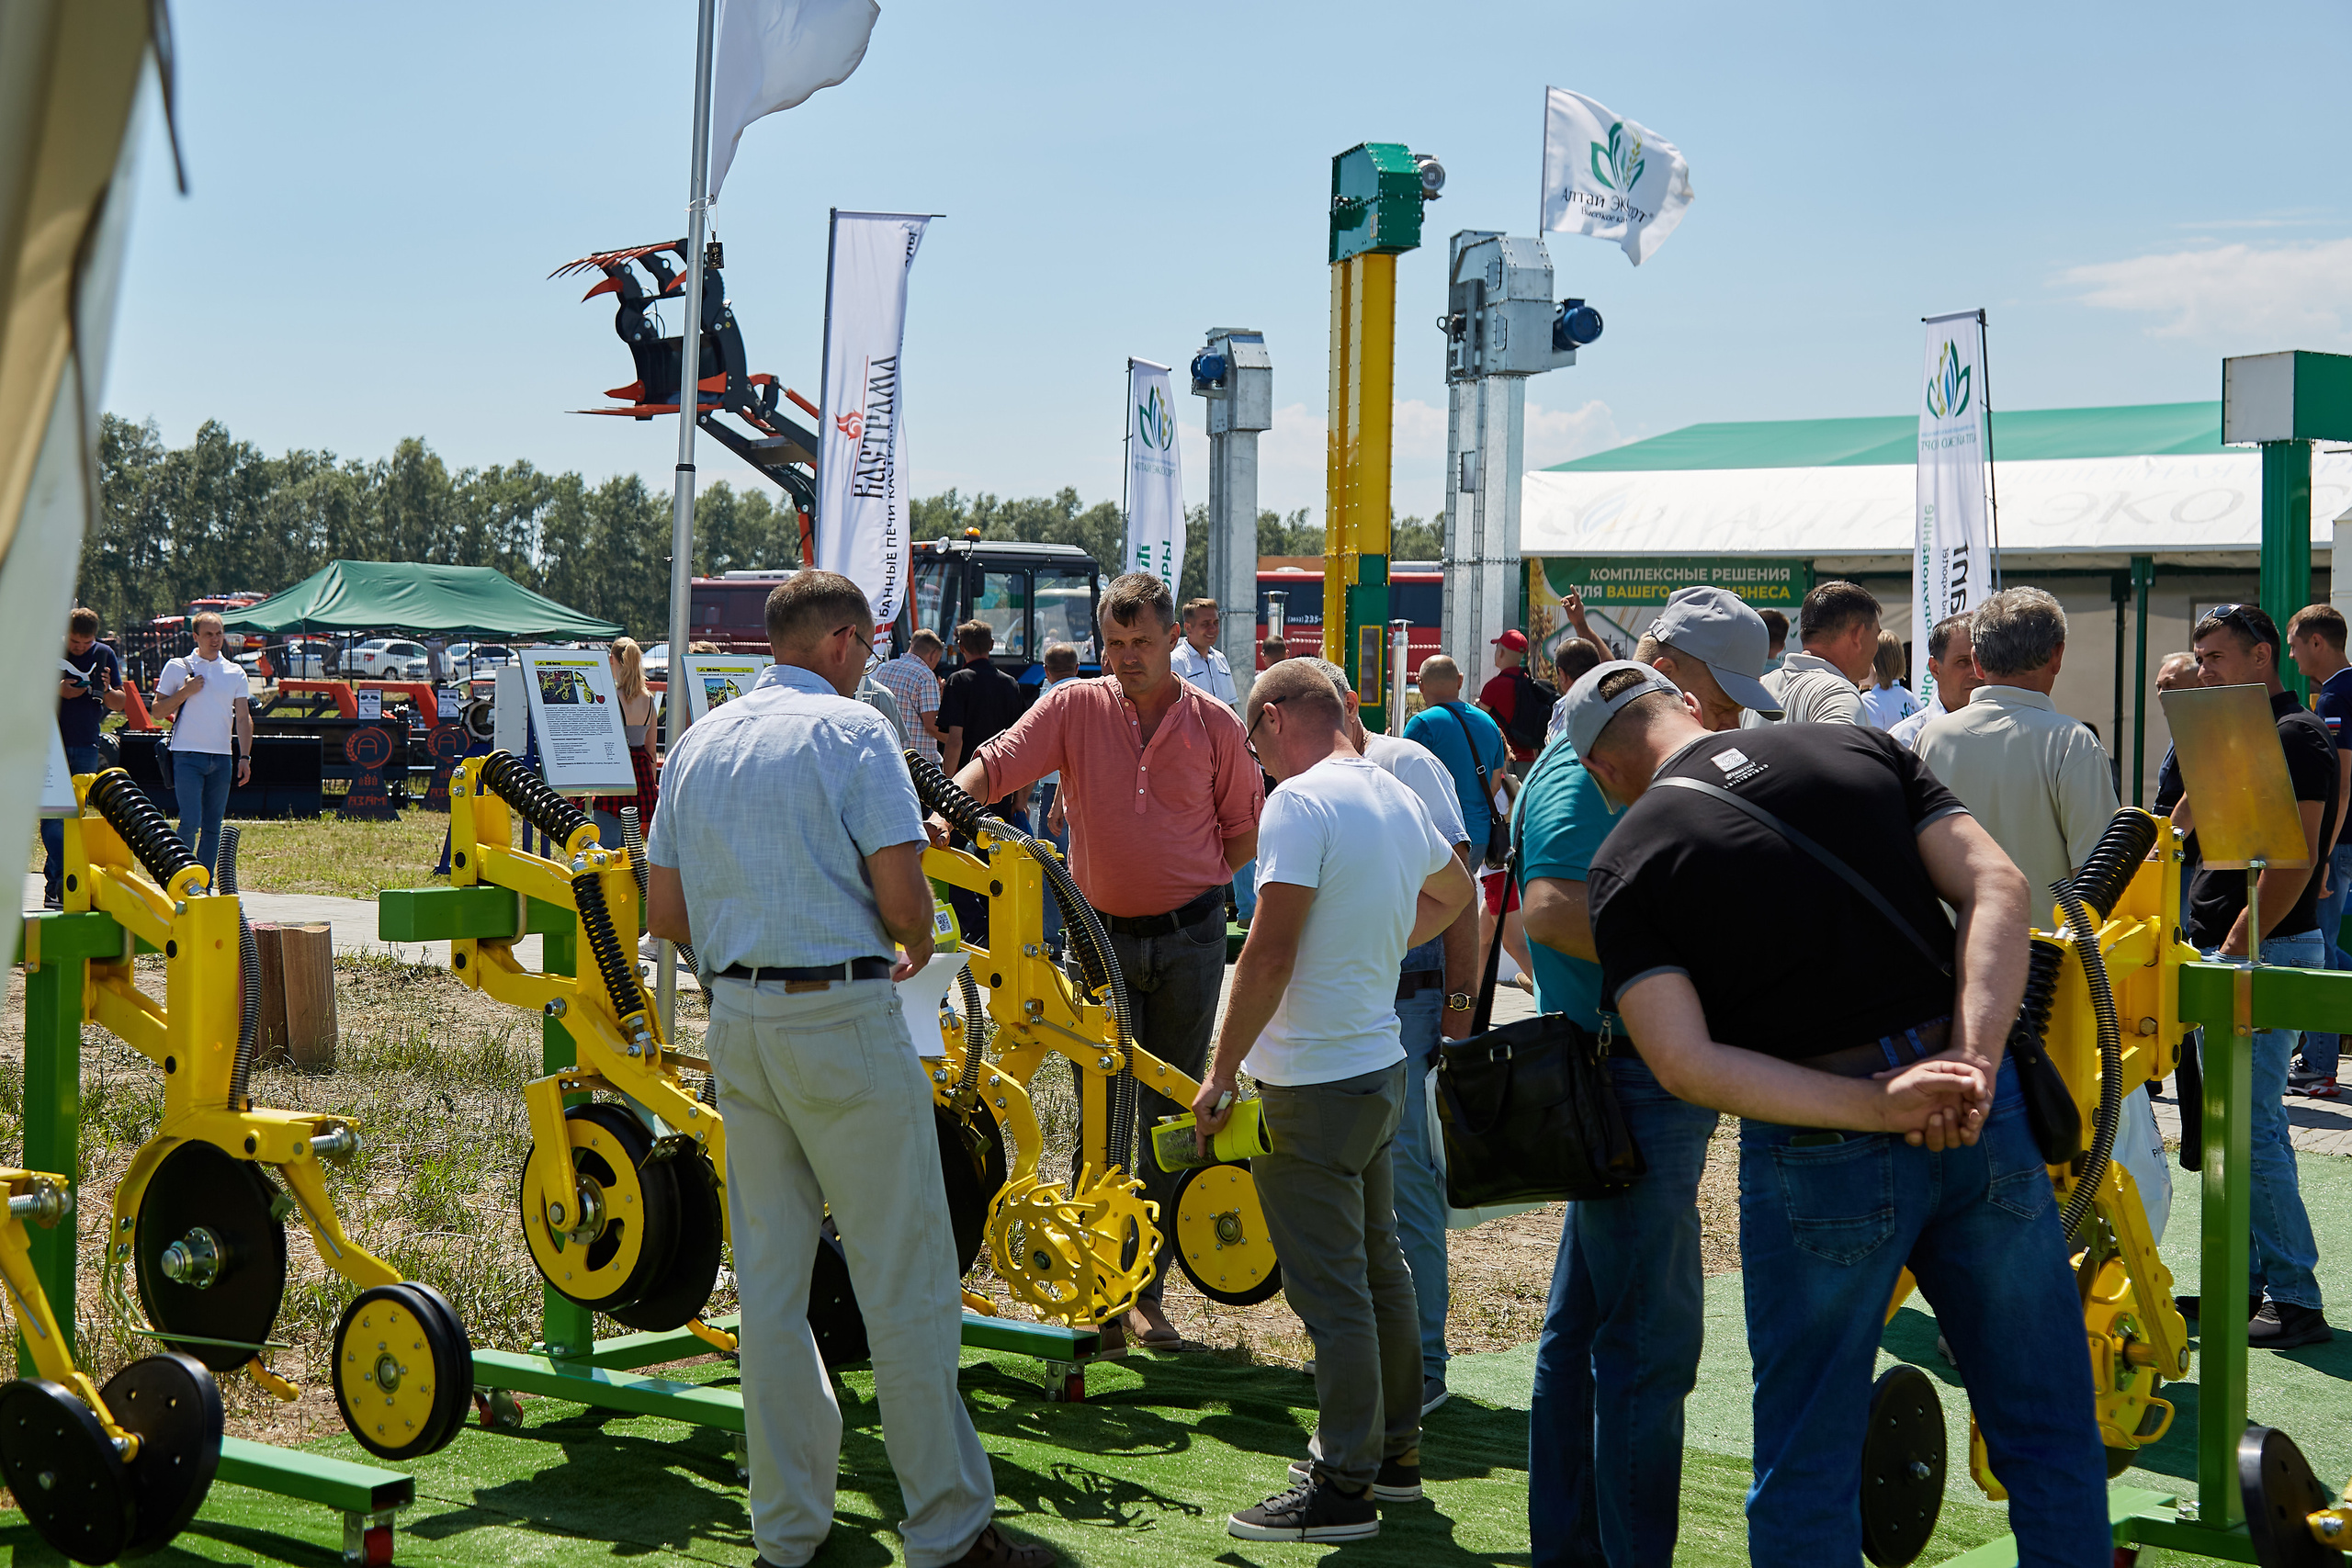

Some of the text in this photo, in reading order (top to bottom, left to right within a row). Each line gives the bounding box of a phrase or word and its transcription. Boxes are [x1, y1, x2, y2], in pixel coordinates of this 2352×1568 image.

[1561, 186, 1605, 208] Алтай
[887, 505, 898, 547] ПЕЧИ
[879, 551, 898, 617] БАННЫЕ
[1589, 568, 1791, 581] КОМПЛЕКСНЫЕ РЕШЕНИЯ
[1607, 585, 1670, 598] ВАШЕГО
